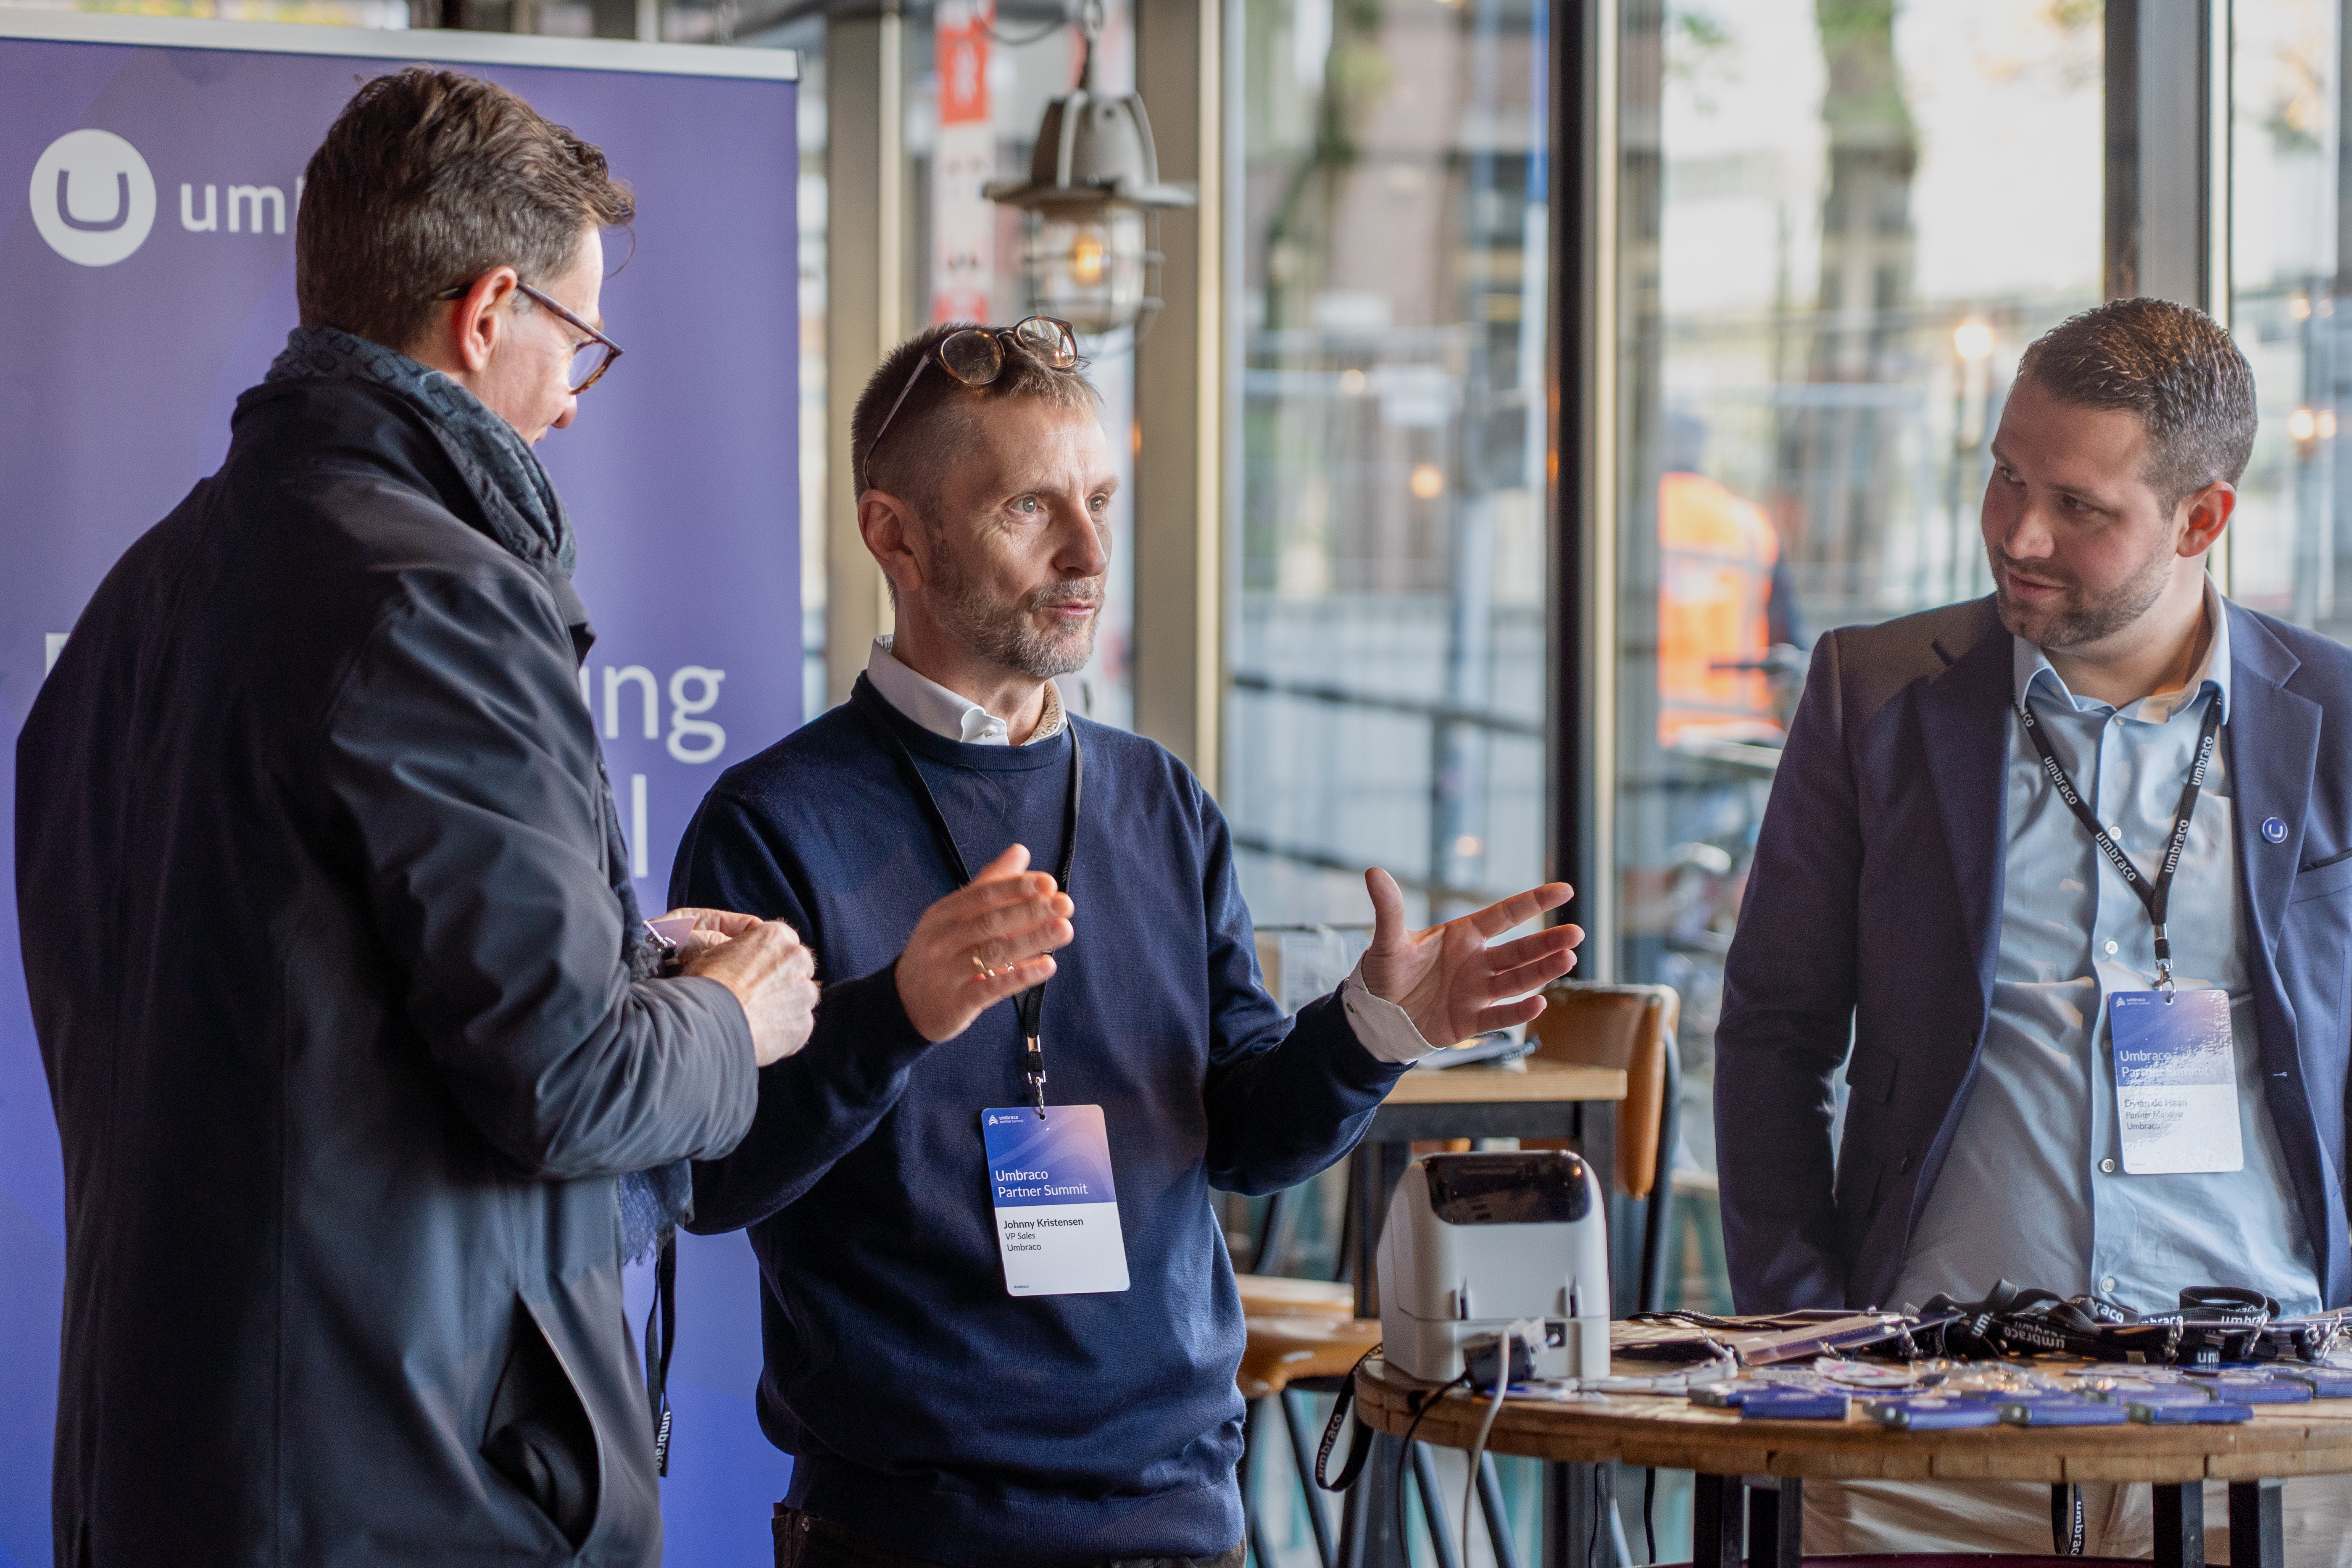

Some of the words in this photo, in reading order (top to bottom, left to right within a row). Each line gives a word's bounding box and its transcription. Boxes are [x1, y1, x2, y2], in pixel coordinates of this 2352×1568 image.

[180, 176, 306, 235] um
[2044, 756, 2078, 805] umbraco
[2191, 735, 2214, 786] umbraco
[2095, 831, 2137, 882] umbraco
[2165, 820, 2189, 874] umbraco
[2120, 1050, 2172, 1062] Umbraco
[2122, 1066, 2164, 1078] Partner
[995, 1169, 1048, 1181] Umbraco
[998, 1186, 1042, 1198] Partner
[1044, 1183, 1088, 1196] Summit
[1004, 1220, 1035, 1229] Johnny
[1037, 1218, 1084, 1227] Kristensen
[1317, 1413, 1343, 1478] umbraco
[2071, 1501, 2083, 1555] umbrac
